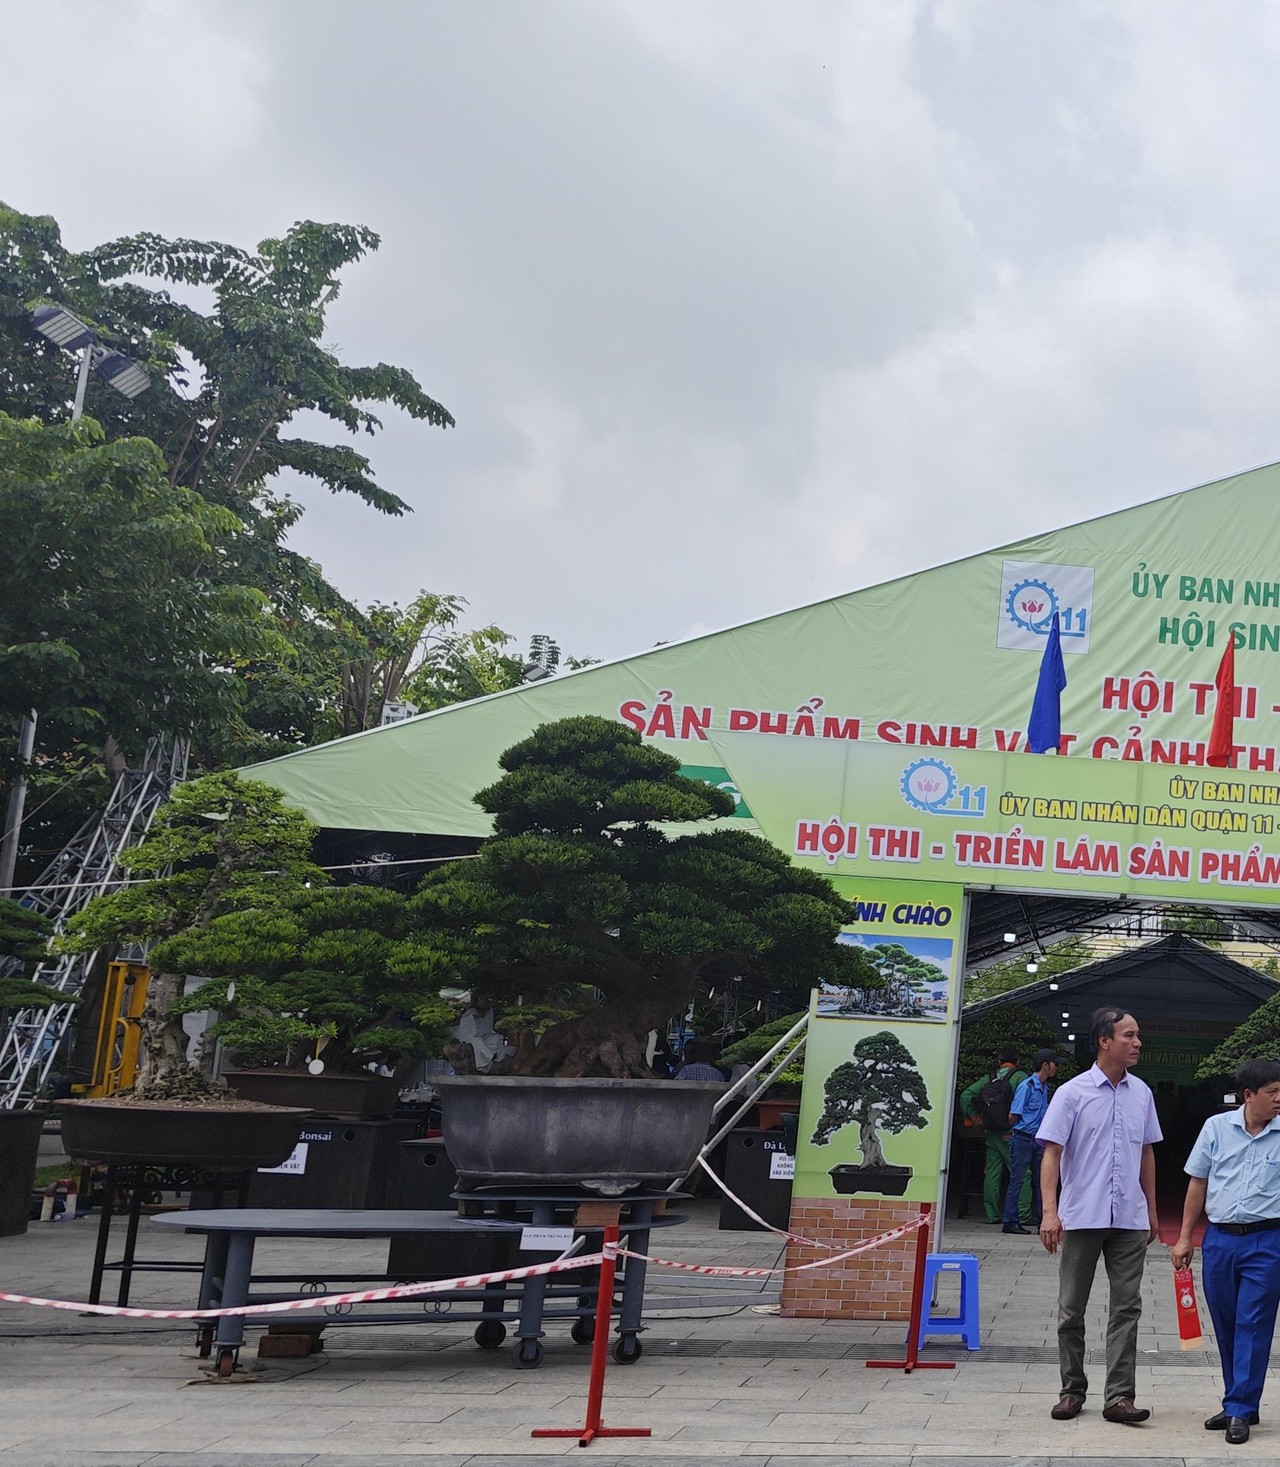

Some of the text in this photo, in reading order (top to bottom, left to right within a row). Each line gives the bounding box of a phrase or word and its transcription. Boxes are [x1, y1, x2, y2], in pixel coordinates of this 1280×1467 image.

[1132, 563, 1169, 599] ỦY
[1179, 576, 1234, 604] BAN
[1158, 611, 1215, 652] HỘI
[1102, 671, 1174, 719] HỘI
[619, 691, 711, 741] SẢN
[994, 729, 1077, 755] VT
[1092, 726, 1209, 767] CẢNH
[957, 785, 986, 811] 11
[1168, 774, 1198, 800] ỦY
[1202, 781, 1245, 802] BAN
[1000, 791, 1030, 816] ỦY
[1033, 797, 1077, 821] BAN
[1081, 799, 1138, 825] NHÂN
[1143, 804, 1187, 829] DÂN
[1191, 807, 1248, 835] QUẬN
[1252, 814, 1274, 835] 11
[797, 818, 857, 861] HỘI
[869, 828, 920, 859] THI
[955, 825, 1044, 867] TRIỂN
[1056, 837, 1119, 873] LÃM
[1130, 840, 1190, 878] SẢN
[893, 901, 952, 926] CHÀO
